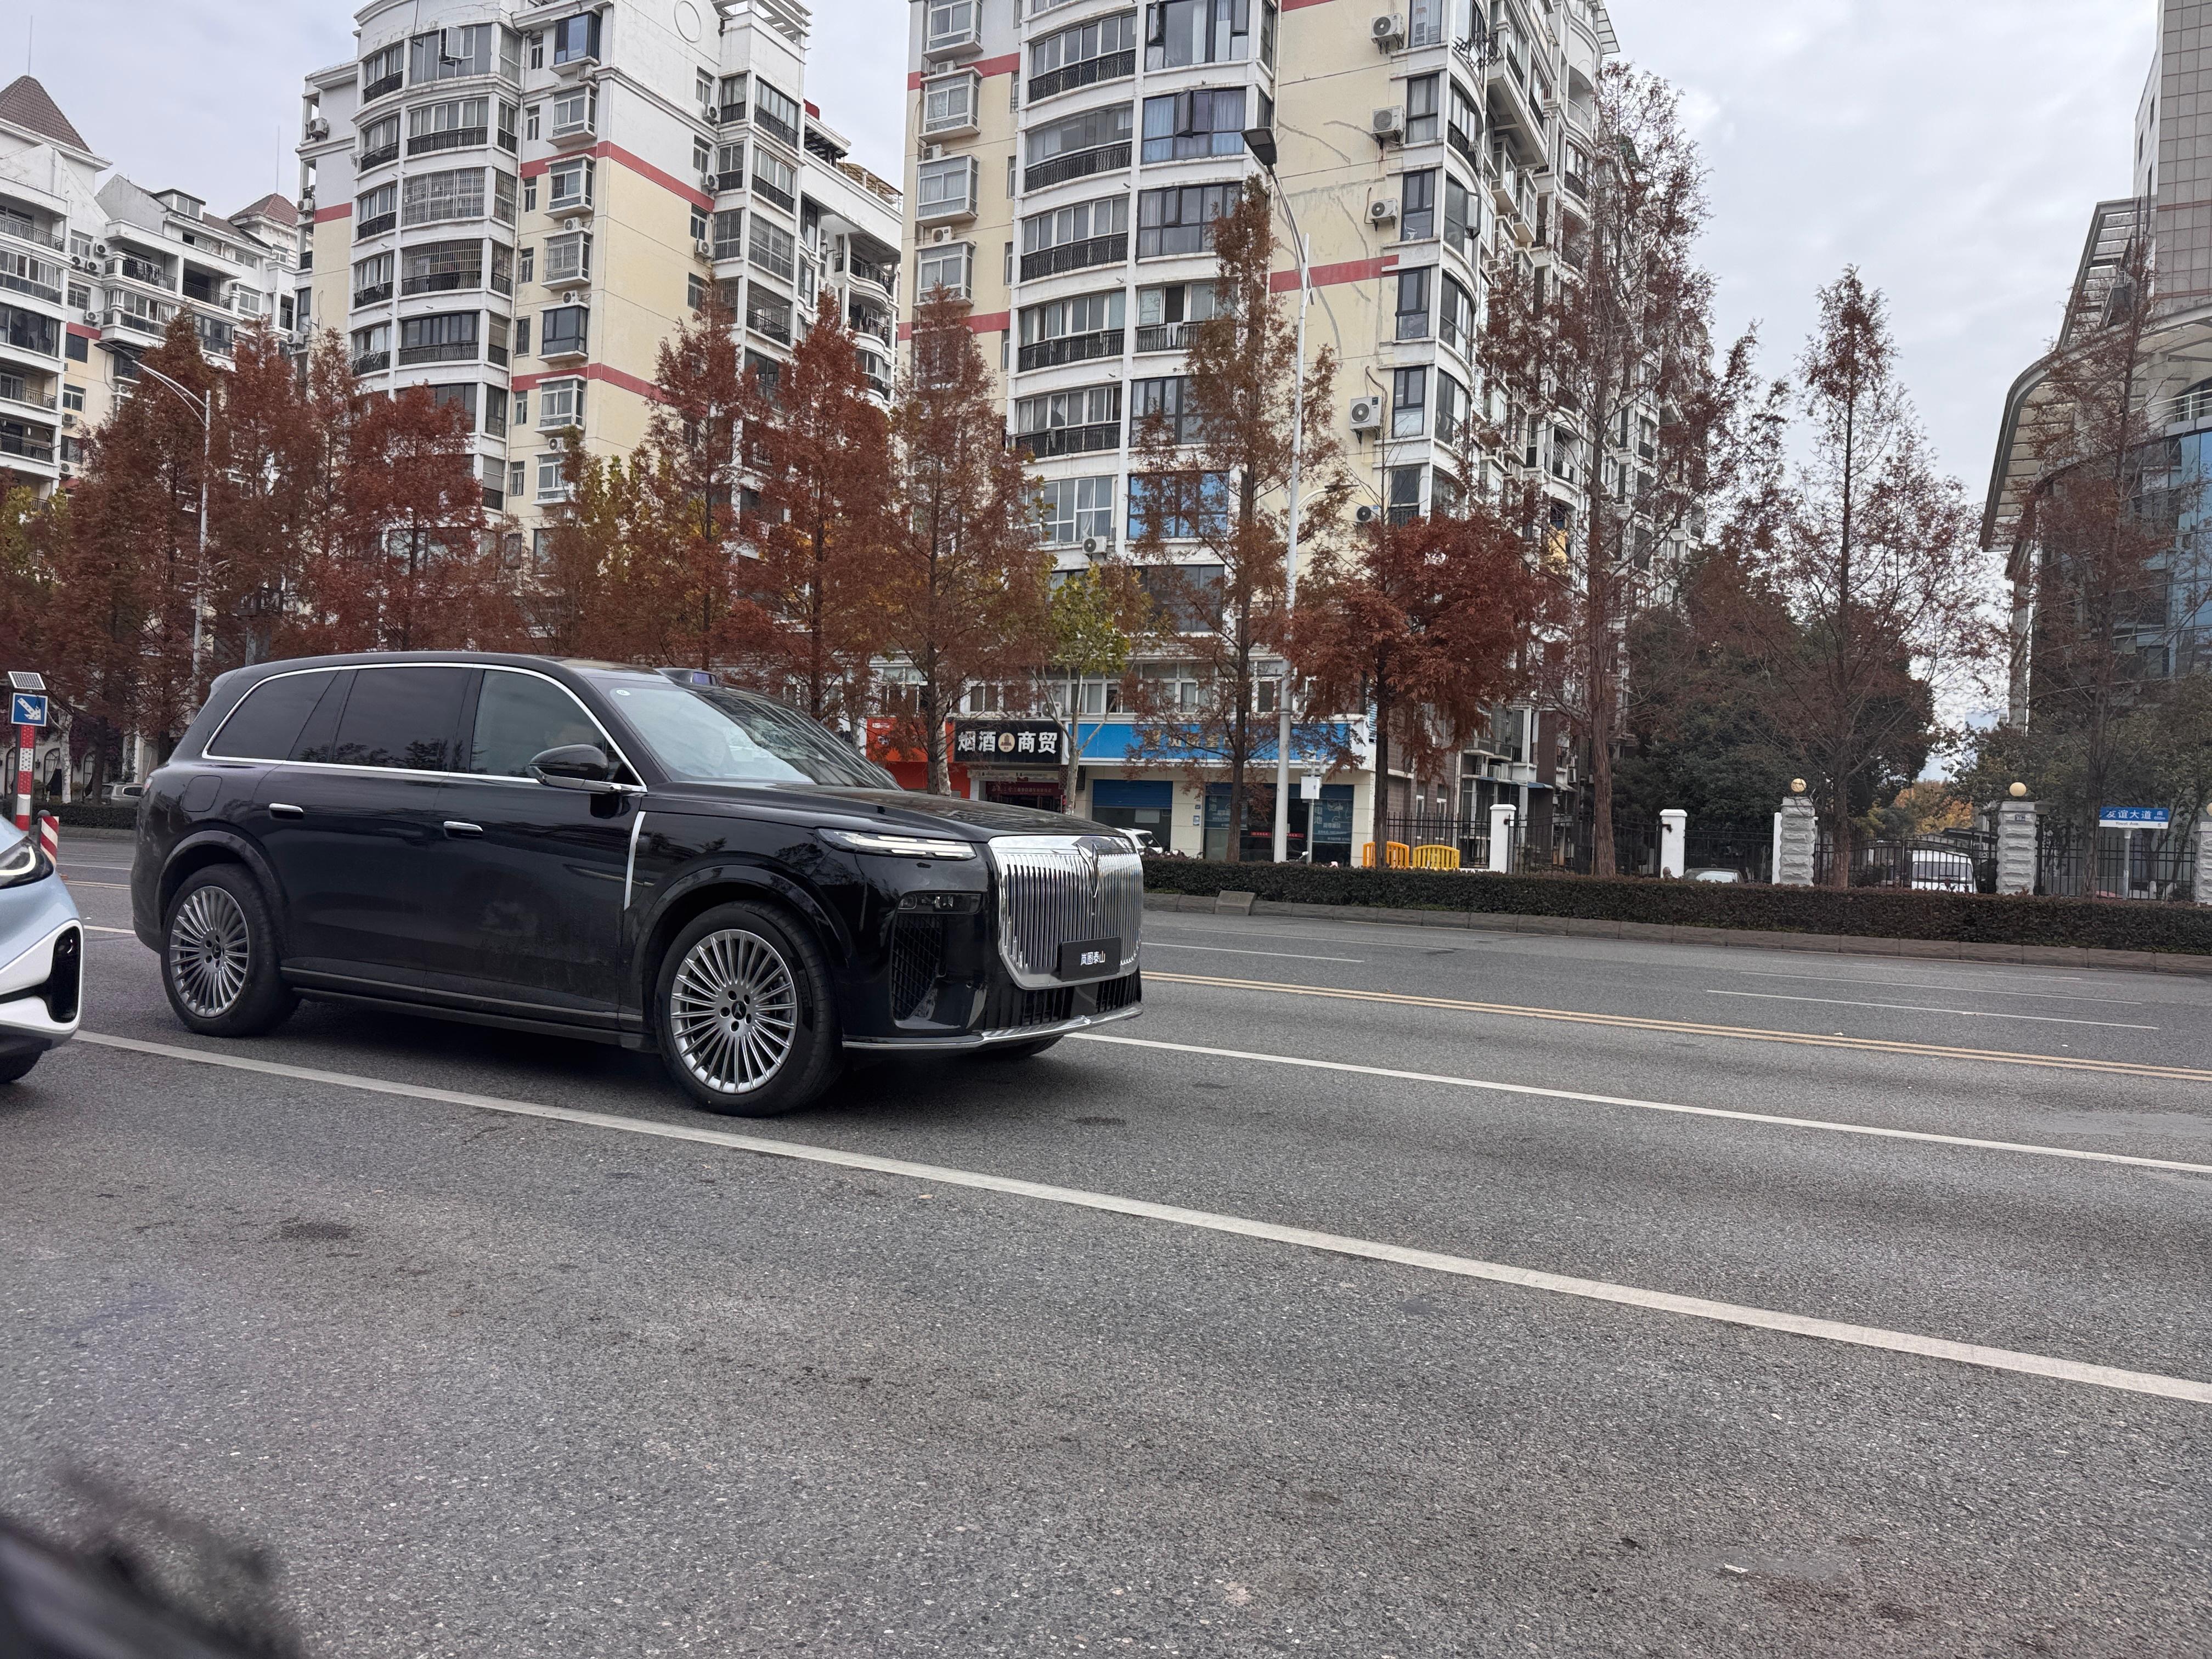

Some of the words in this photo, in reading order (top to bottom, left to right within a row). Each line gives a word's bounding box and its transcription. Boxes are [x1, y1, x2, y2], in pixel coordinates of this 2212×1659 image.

[958, 731, 996, 752] 烟酒
[1017, 731, 1058, 754] 商贸
[2106, 810, 2152, 820] 友谊大道
[1080, 951, 1106, 966] 岚图泰山
